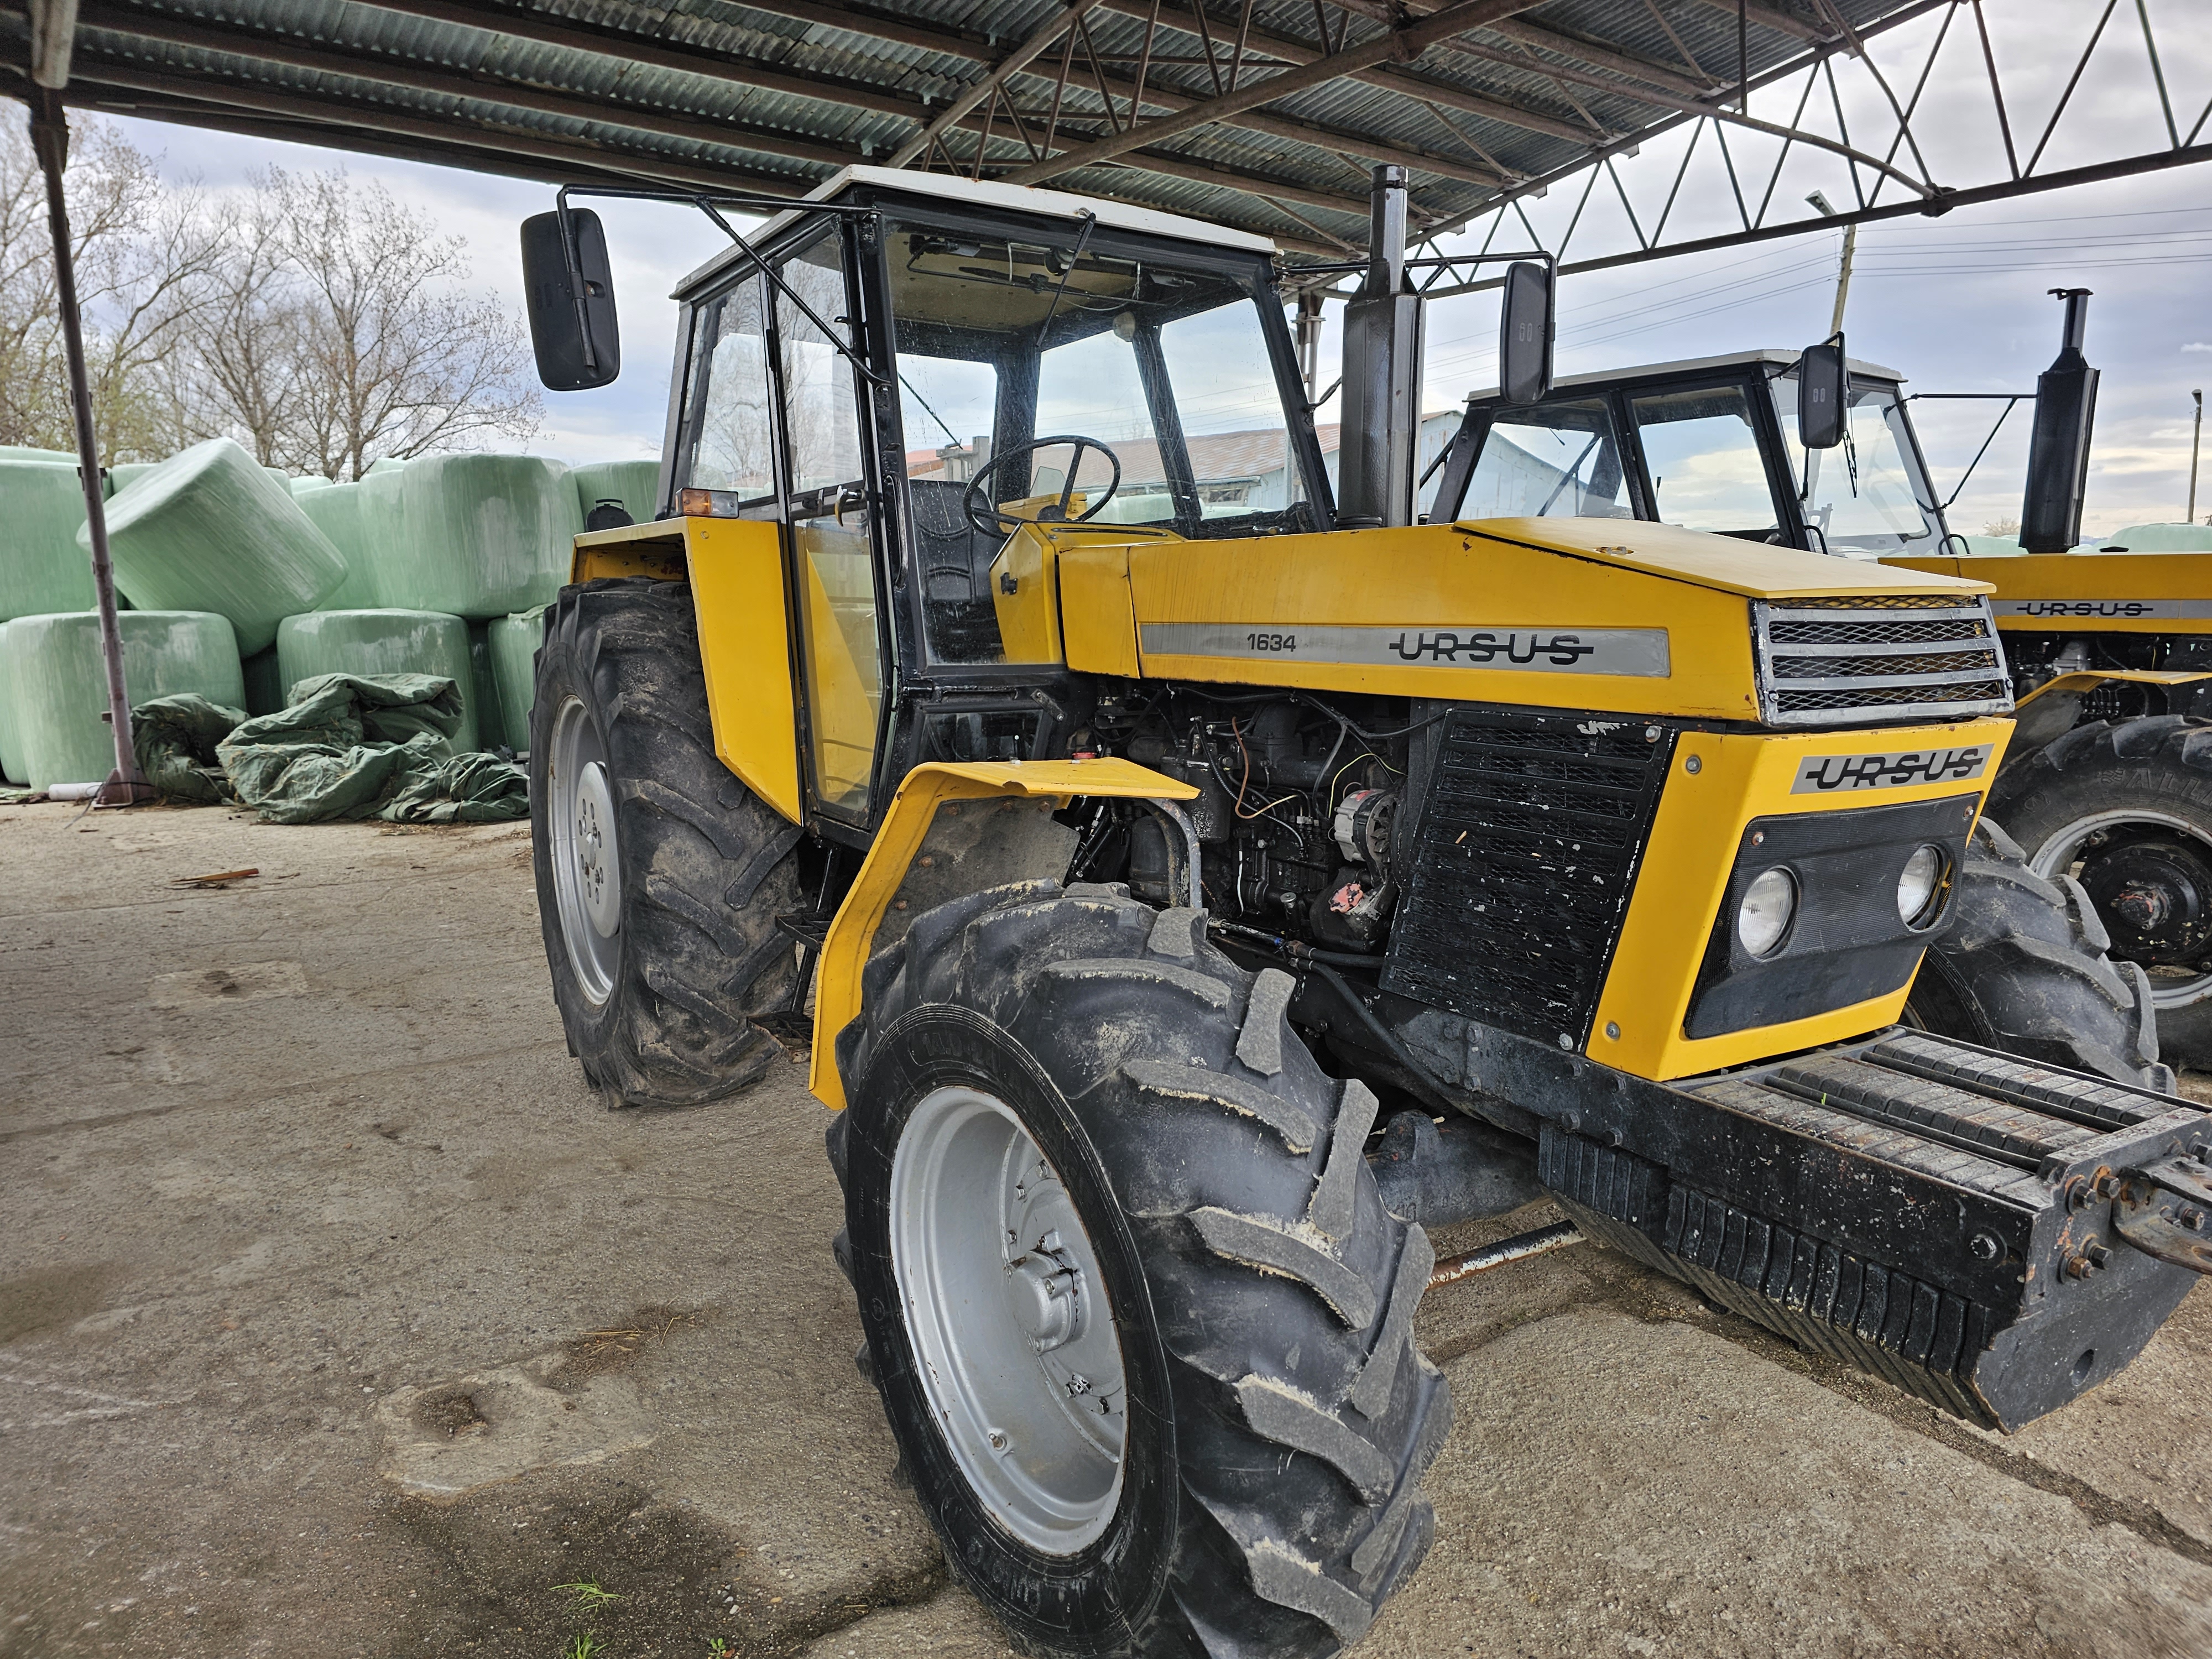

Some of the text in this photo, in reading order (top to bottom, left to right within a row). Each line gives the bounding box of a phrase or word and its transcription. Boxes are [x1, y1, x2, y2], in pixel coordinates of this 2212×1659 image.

[2016, 602, 2153, 617] URSUS
[1247, 633, 1594, 665] 1634 URSUS
[1806, 748, 1984, 790] URSUS
